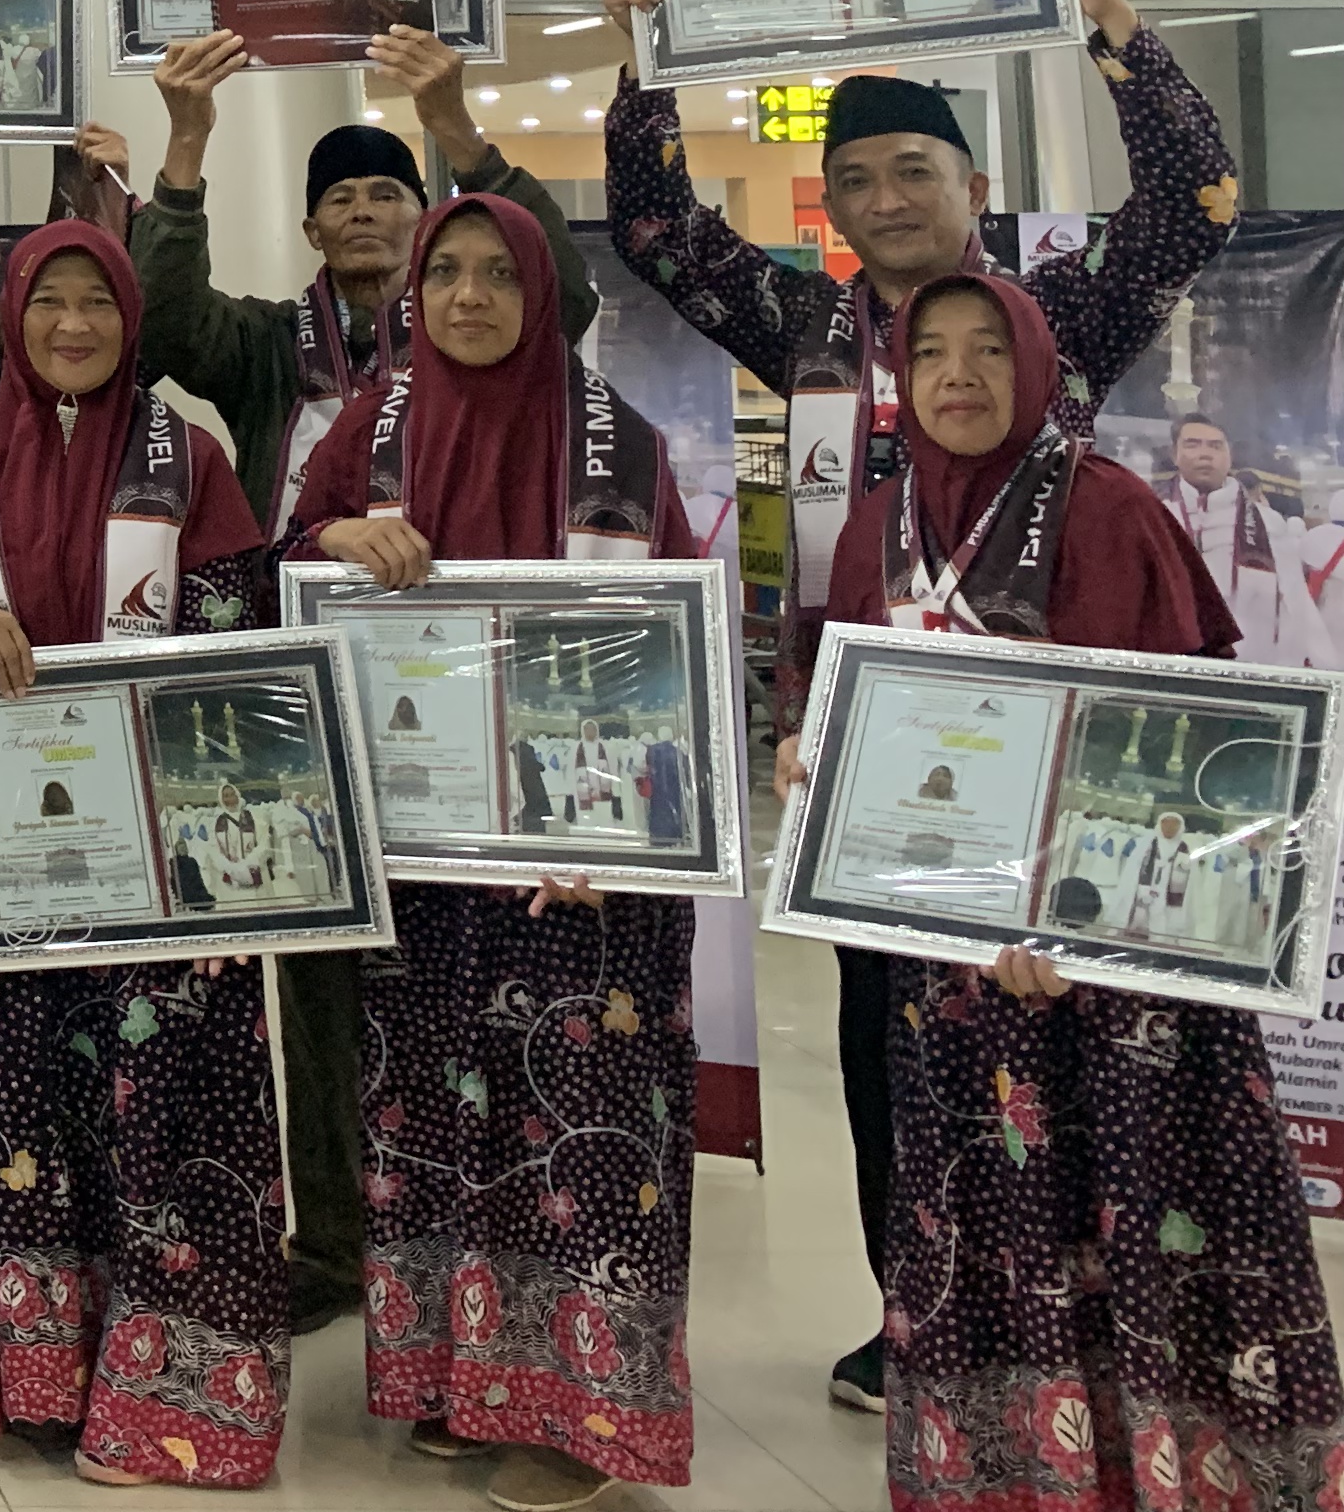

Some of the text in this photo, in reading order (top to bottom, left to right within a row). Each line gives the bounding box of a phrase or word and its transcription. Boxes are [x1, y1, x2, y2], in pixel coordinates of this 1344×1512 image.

[793, 484, 847, 500] MUSLIMAH
[1, 733, 74, 754] Sertifikat
[1263, 1032, 1294, 1049] dah
[1276, 1071, 1338, 1091] Alamin
[1277, 1097, 1333, 1114] VEMBER
